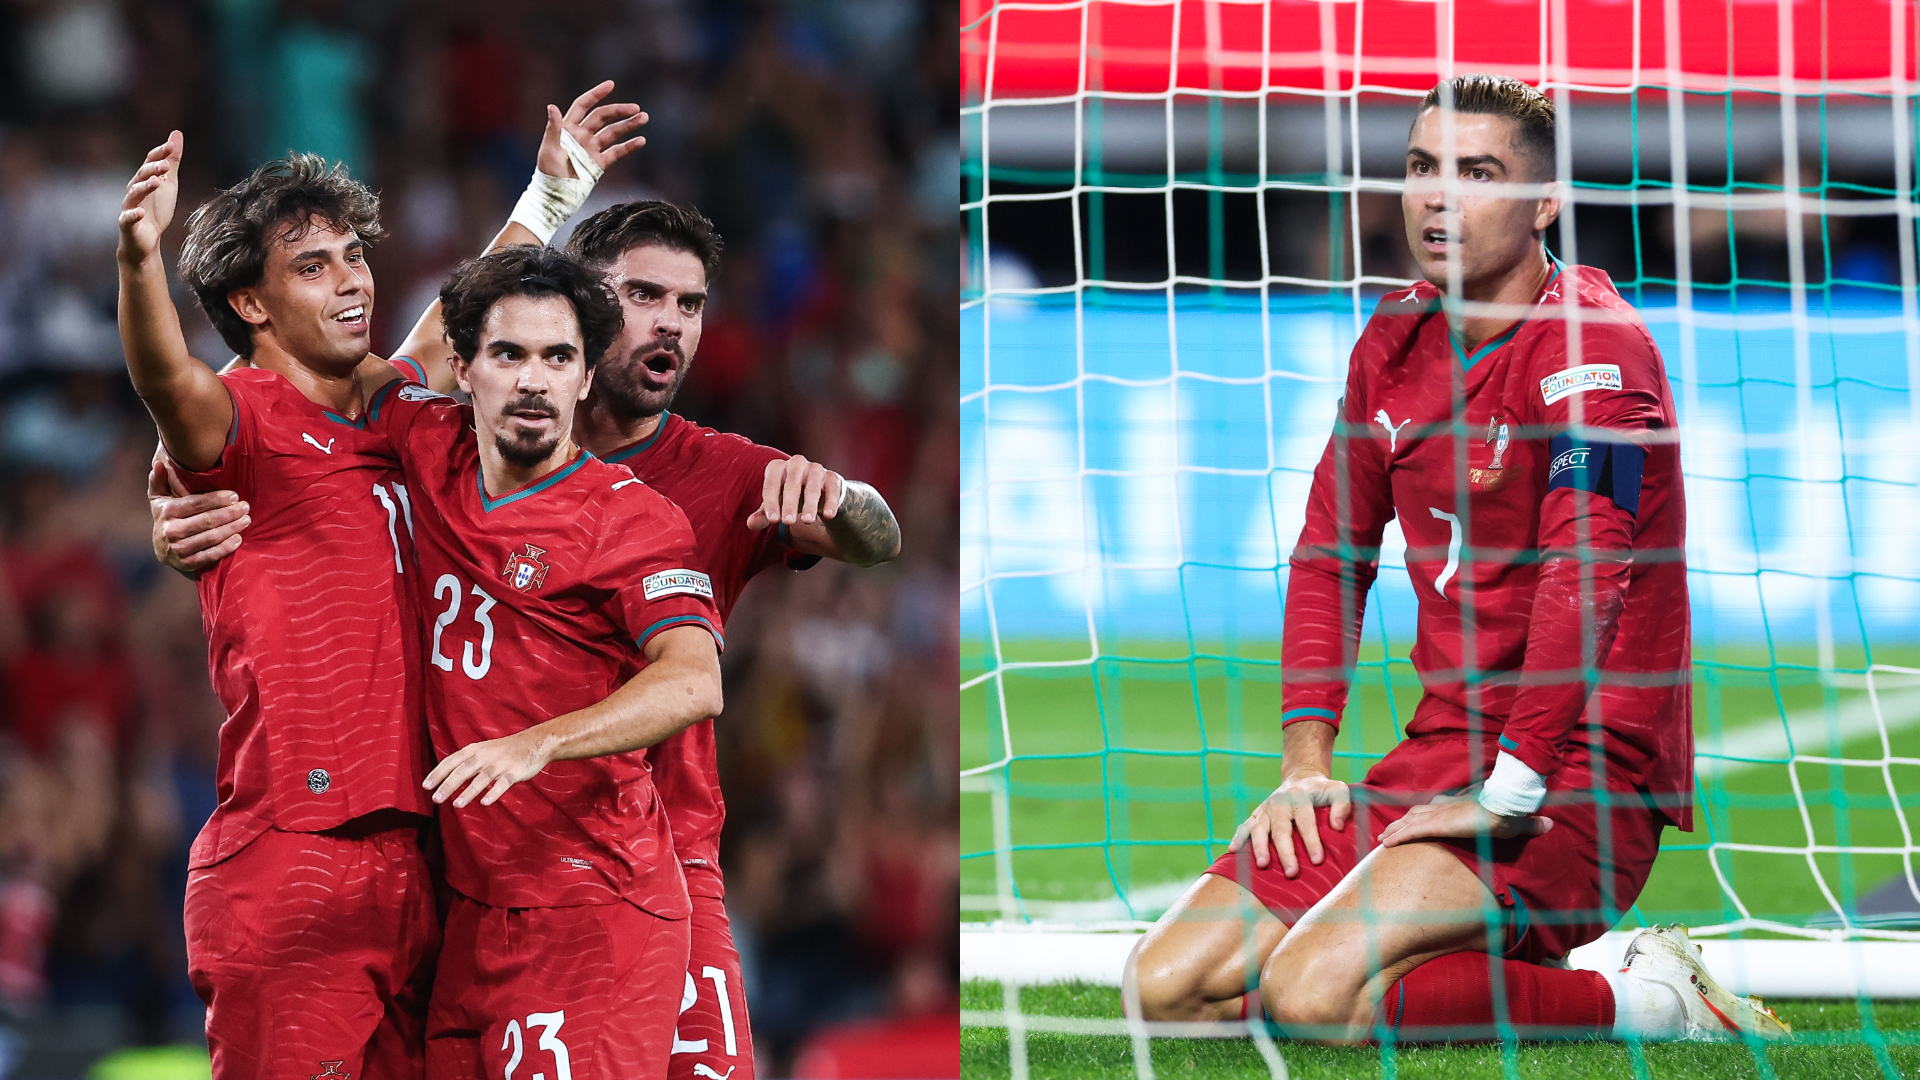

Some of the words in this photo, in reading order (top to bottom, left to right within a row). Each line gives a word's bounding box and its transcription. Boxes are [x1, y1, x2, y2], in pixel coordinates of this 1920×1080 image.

[1542, 376, 1558, 387] UEFA
[1543, 372, 1620, 396] FOUNDATION
[1549, 452, 1590, 478] ESPECT
[373, 481, 419, 573] 11
[1429, 507, 1462, 601] 7
[644, 574, 660, 584] UEFA
[645, 576, 711, 592] FOUNDATION
[431, 573, 498, 681] 23
[671, 966, 738, 1057] 21
[501, 1009, 573, 1080] 23
